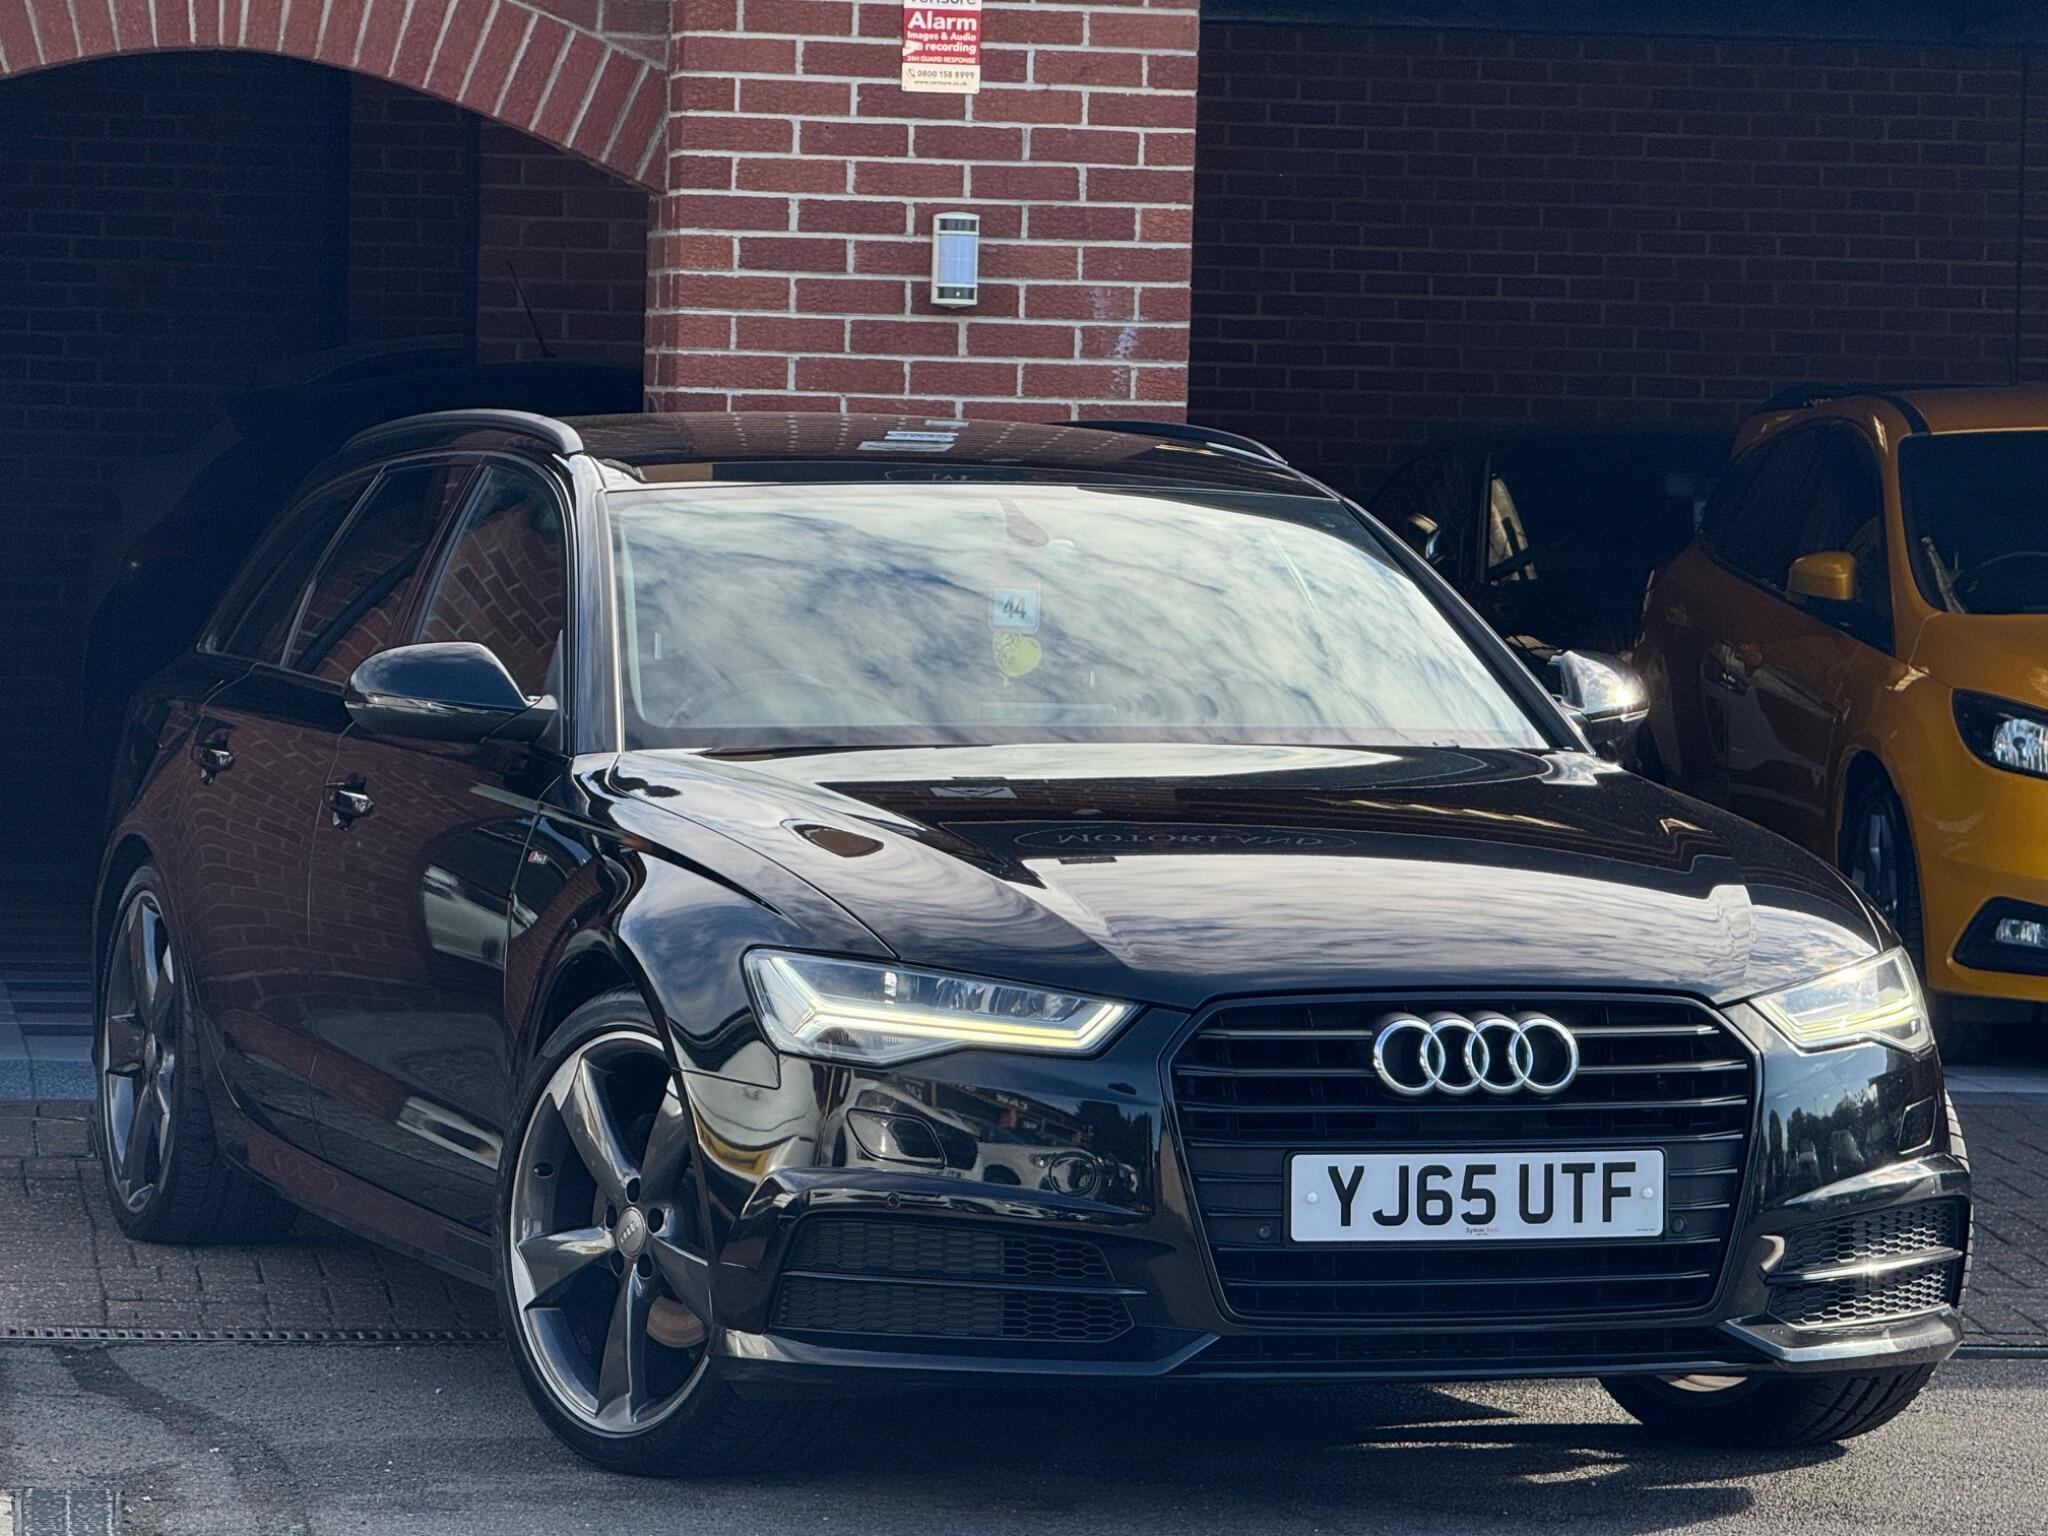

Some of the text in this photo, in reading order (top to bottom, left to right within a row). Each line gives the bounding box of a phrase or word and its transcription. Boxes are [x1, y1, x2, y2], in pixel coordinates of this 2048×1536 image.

[907, 10, 977, 30] Alarm
[907, 31, 938, 41] Images
[950, 32, 977, 41] Audio
[925, 42, 977, 55] recording
[917, 70, 937, 78] 0800
[1003, 597, 1026, 619] 44
[1328, 1162, 1637, 1227] YJ65 UTF
